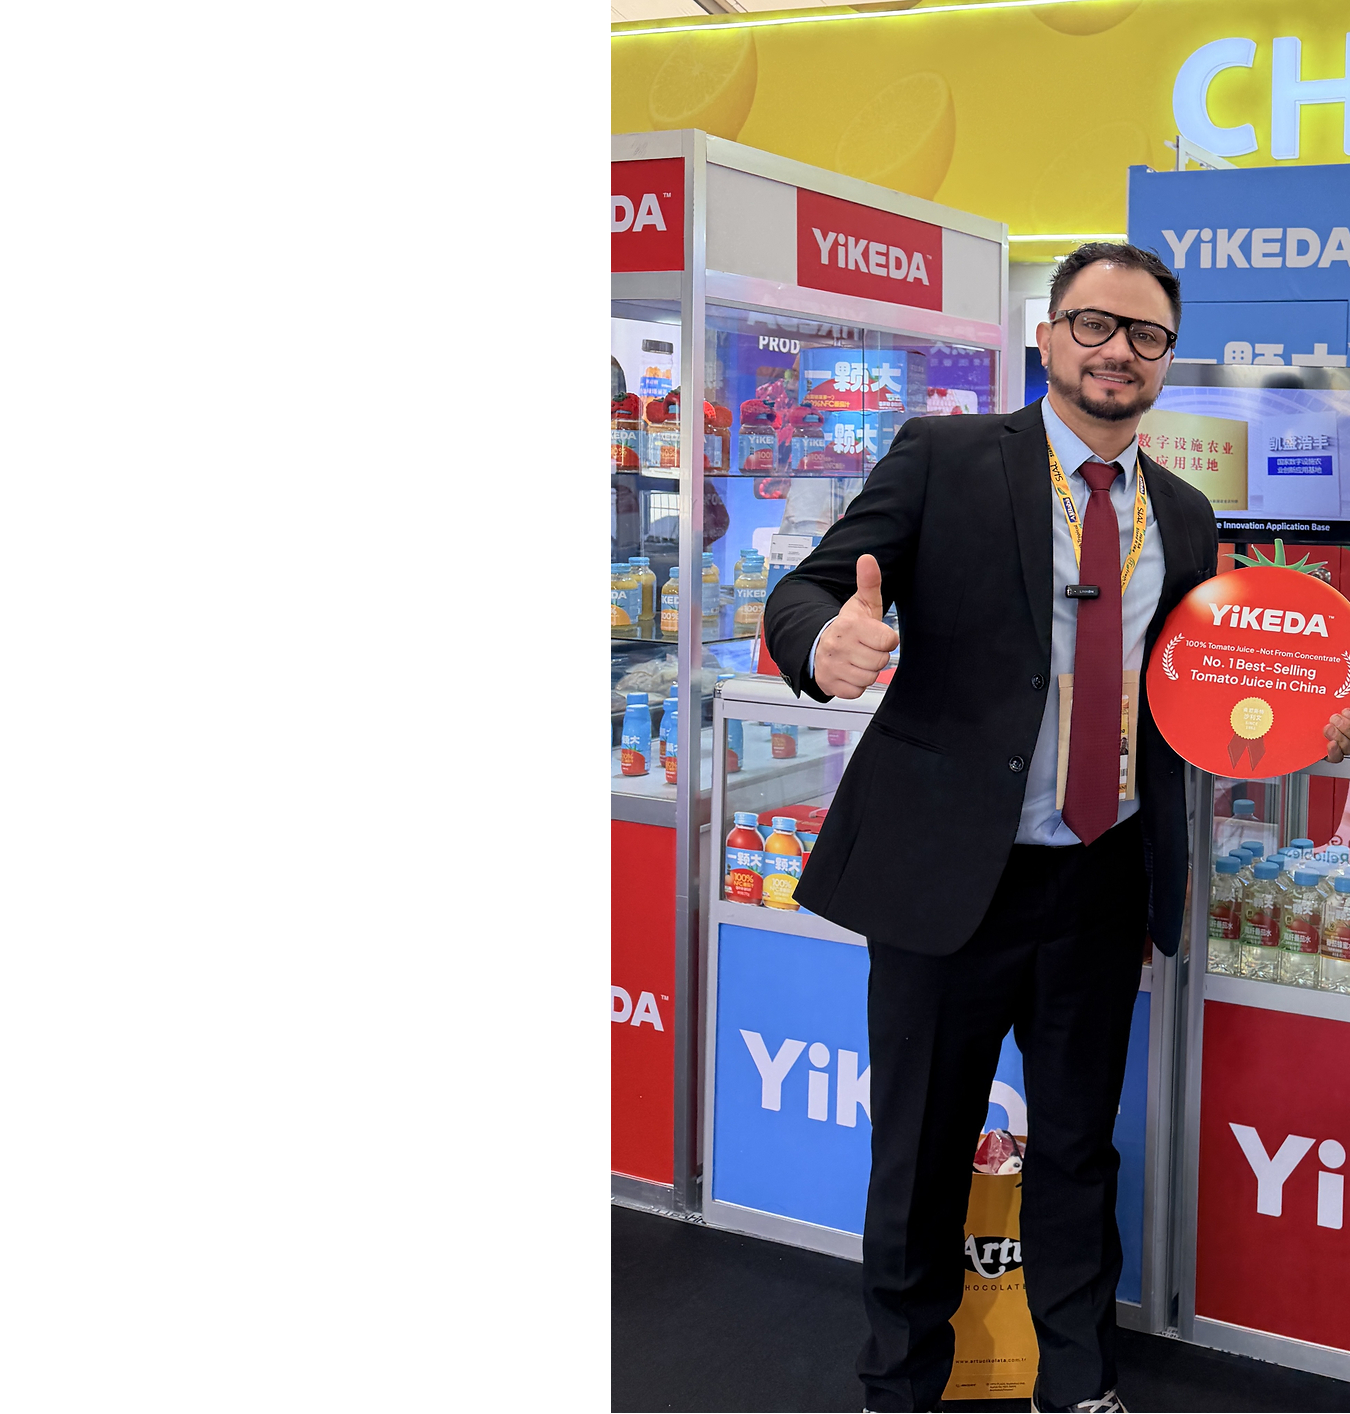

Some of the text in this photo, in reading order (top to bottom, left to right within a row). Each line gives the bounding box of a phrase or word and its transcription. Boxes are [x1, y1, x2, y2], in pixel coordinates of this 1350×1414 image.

[812, 228, 929, 286] YiKEDA
[804, 361, 902, 392] 一颗大
[1223, 521, 1265, 530] Innovation
[1266, 522, 1310, 532] Application
[1311, 523, 1330, 531] Base
[1208, 602, 1329, 638] YiKEDA
[1185, 640, 1207, 649] 100%
[1208, 642, 1235, 652] Tomato
[1235, 644, 1255, 654] Juice
[1274, 648, 1294, 658] From
[1294, 651, 1341, 663] Concentrate
[1202, 655, 1317, 680] No. 1 Best-Selling
[1190, 669, 1327, 696] Tomato Juice in China
[727, 851, 762, 867] 一颗大
[765, 856, 800, 873] 一颗大
[733, 872, 754, 884] 100%
